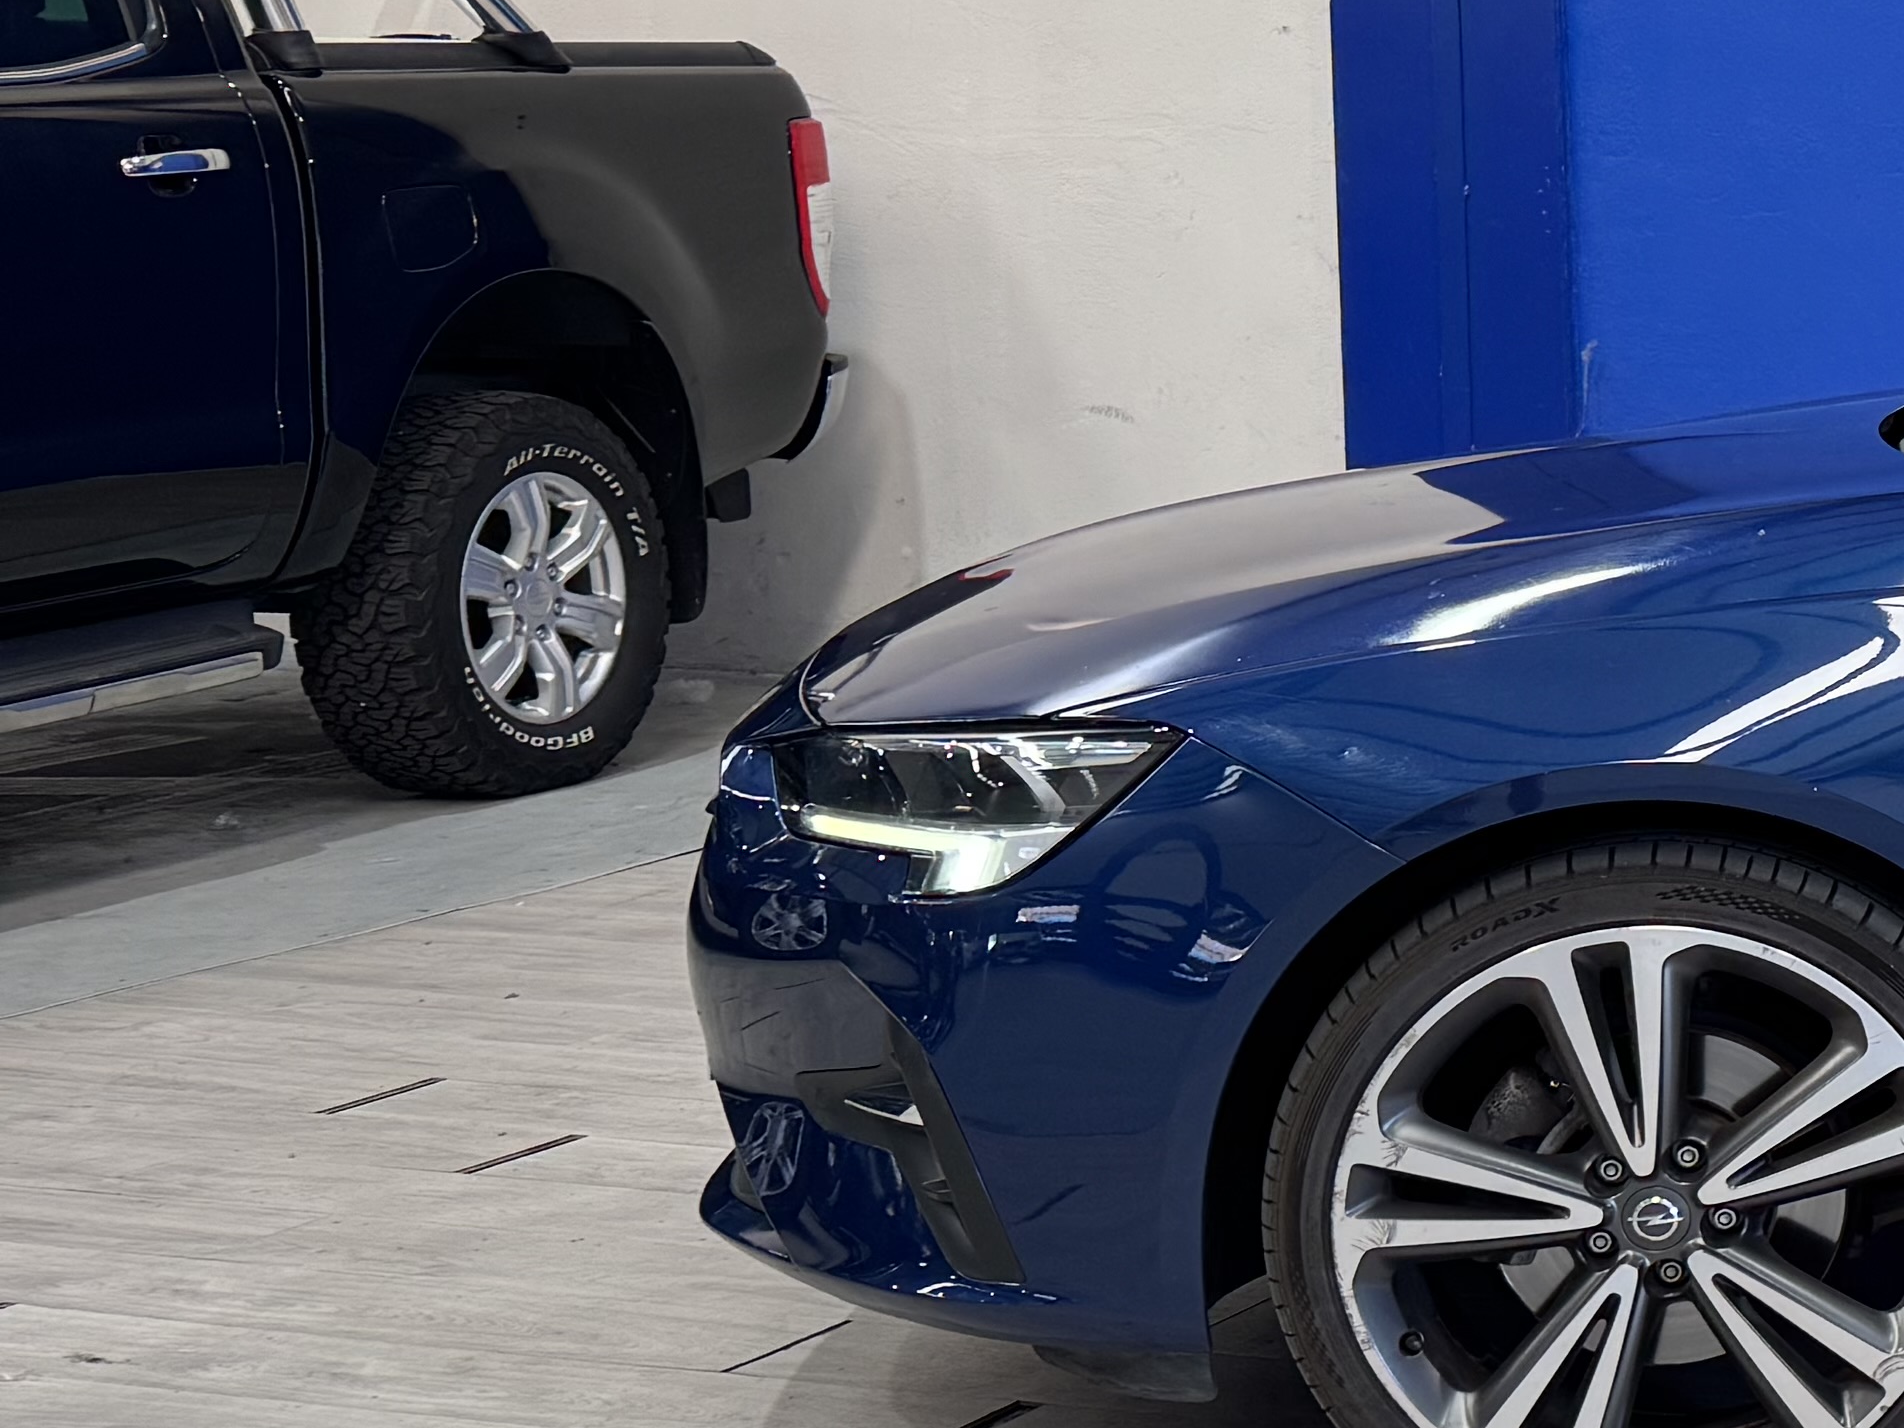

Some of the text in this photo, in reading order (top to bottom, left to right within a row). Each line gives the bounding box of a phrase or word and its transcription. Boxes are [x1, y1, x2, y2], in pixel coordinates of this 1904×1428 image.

[503, 443, 649, 557] All-Terrain T/A
[463, 666, 595, 750] BFGoodrich
[1448, 895, 1562, 953] ROADX
